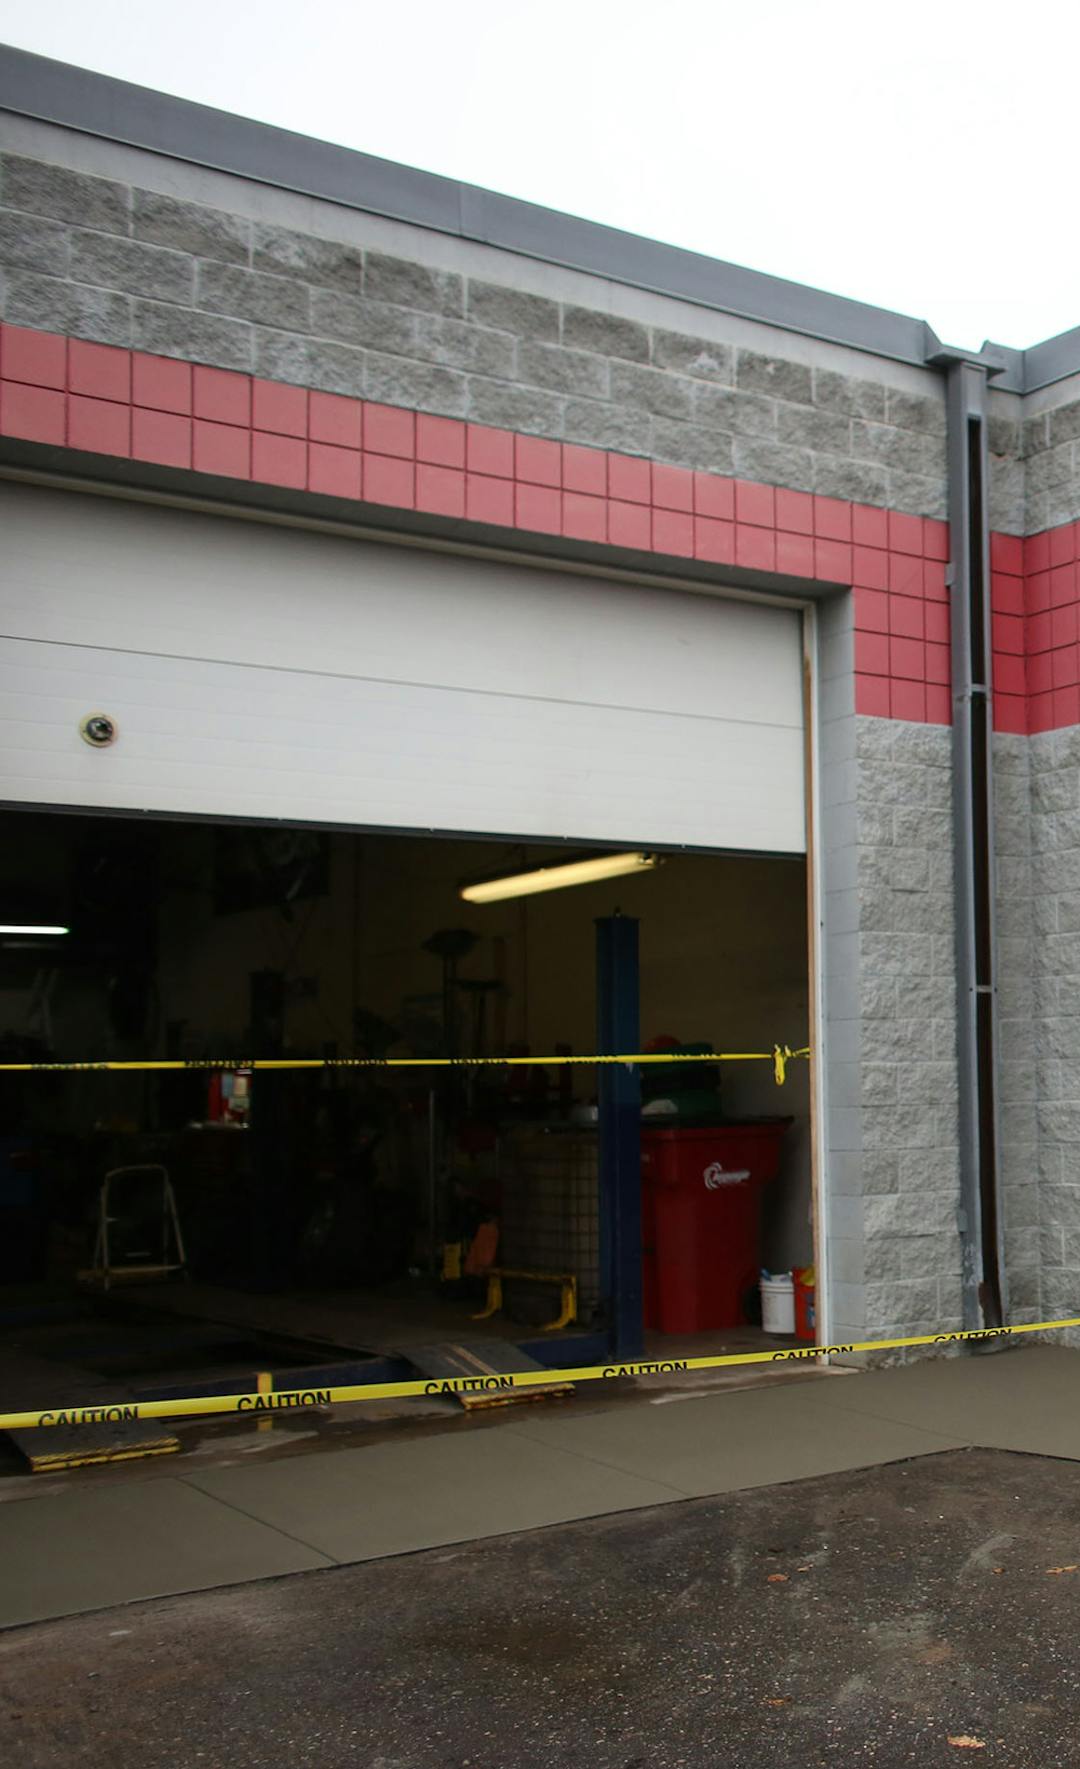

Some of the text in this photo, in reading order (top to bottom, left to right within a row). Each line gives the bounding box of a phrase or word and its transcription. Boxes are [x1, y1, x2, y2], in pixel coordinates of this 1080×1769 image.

[38, 1405, 139, 1427] CAUTION
[237, 1390, 331, 1411] CAUTION
[424, 1376, 514, 1396] CAUTION
[602, 1361, 688, 1379] CAUTION
